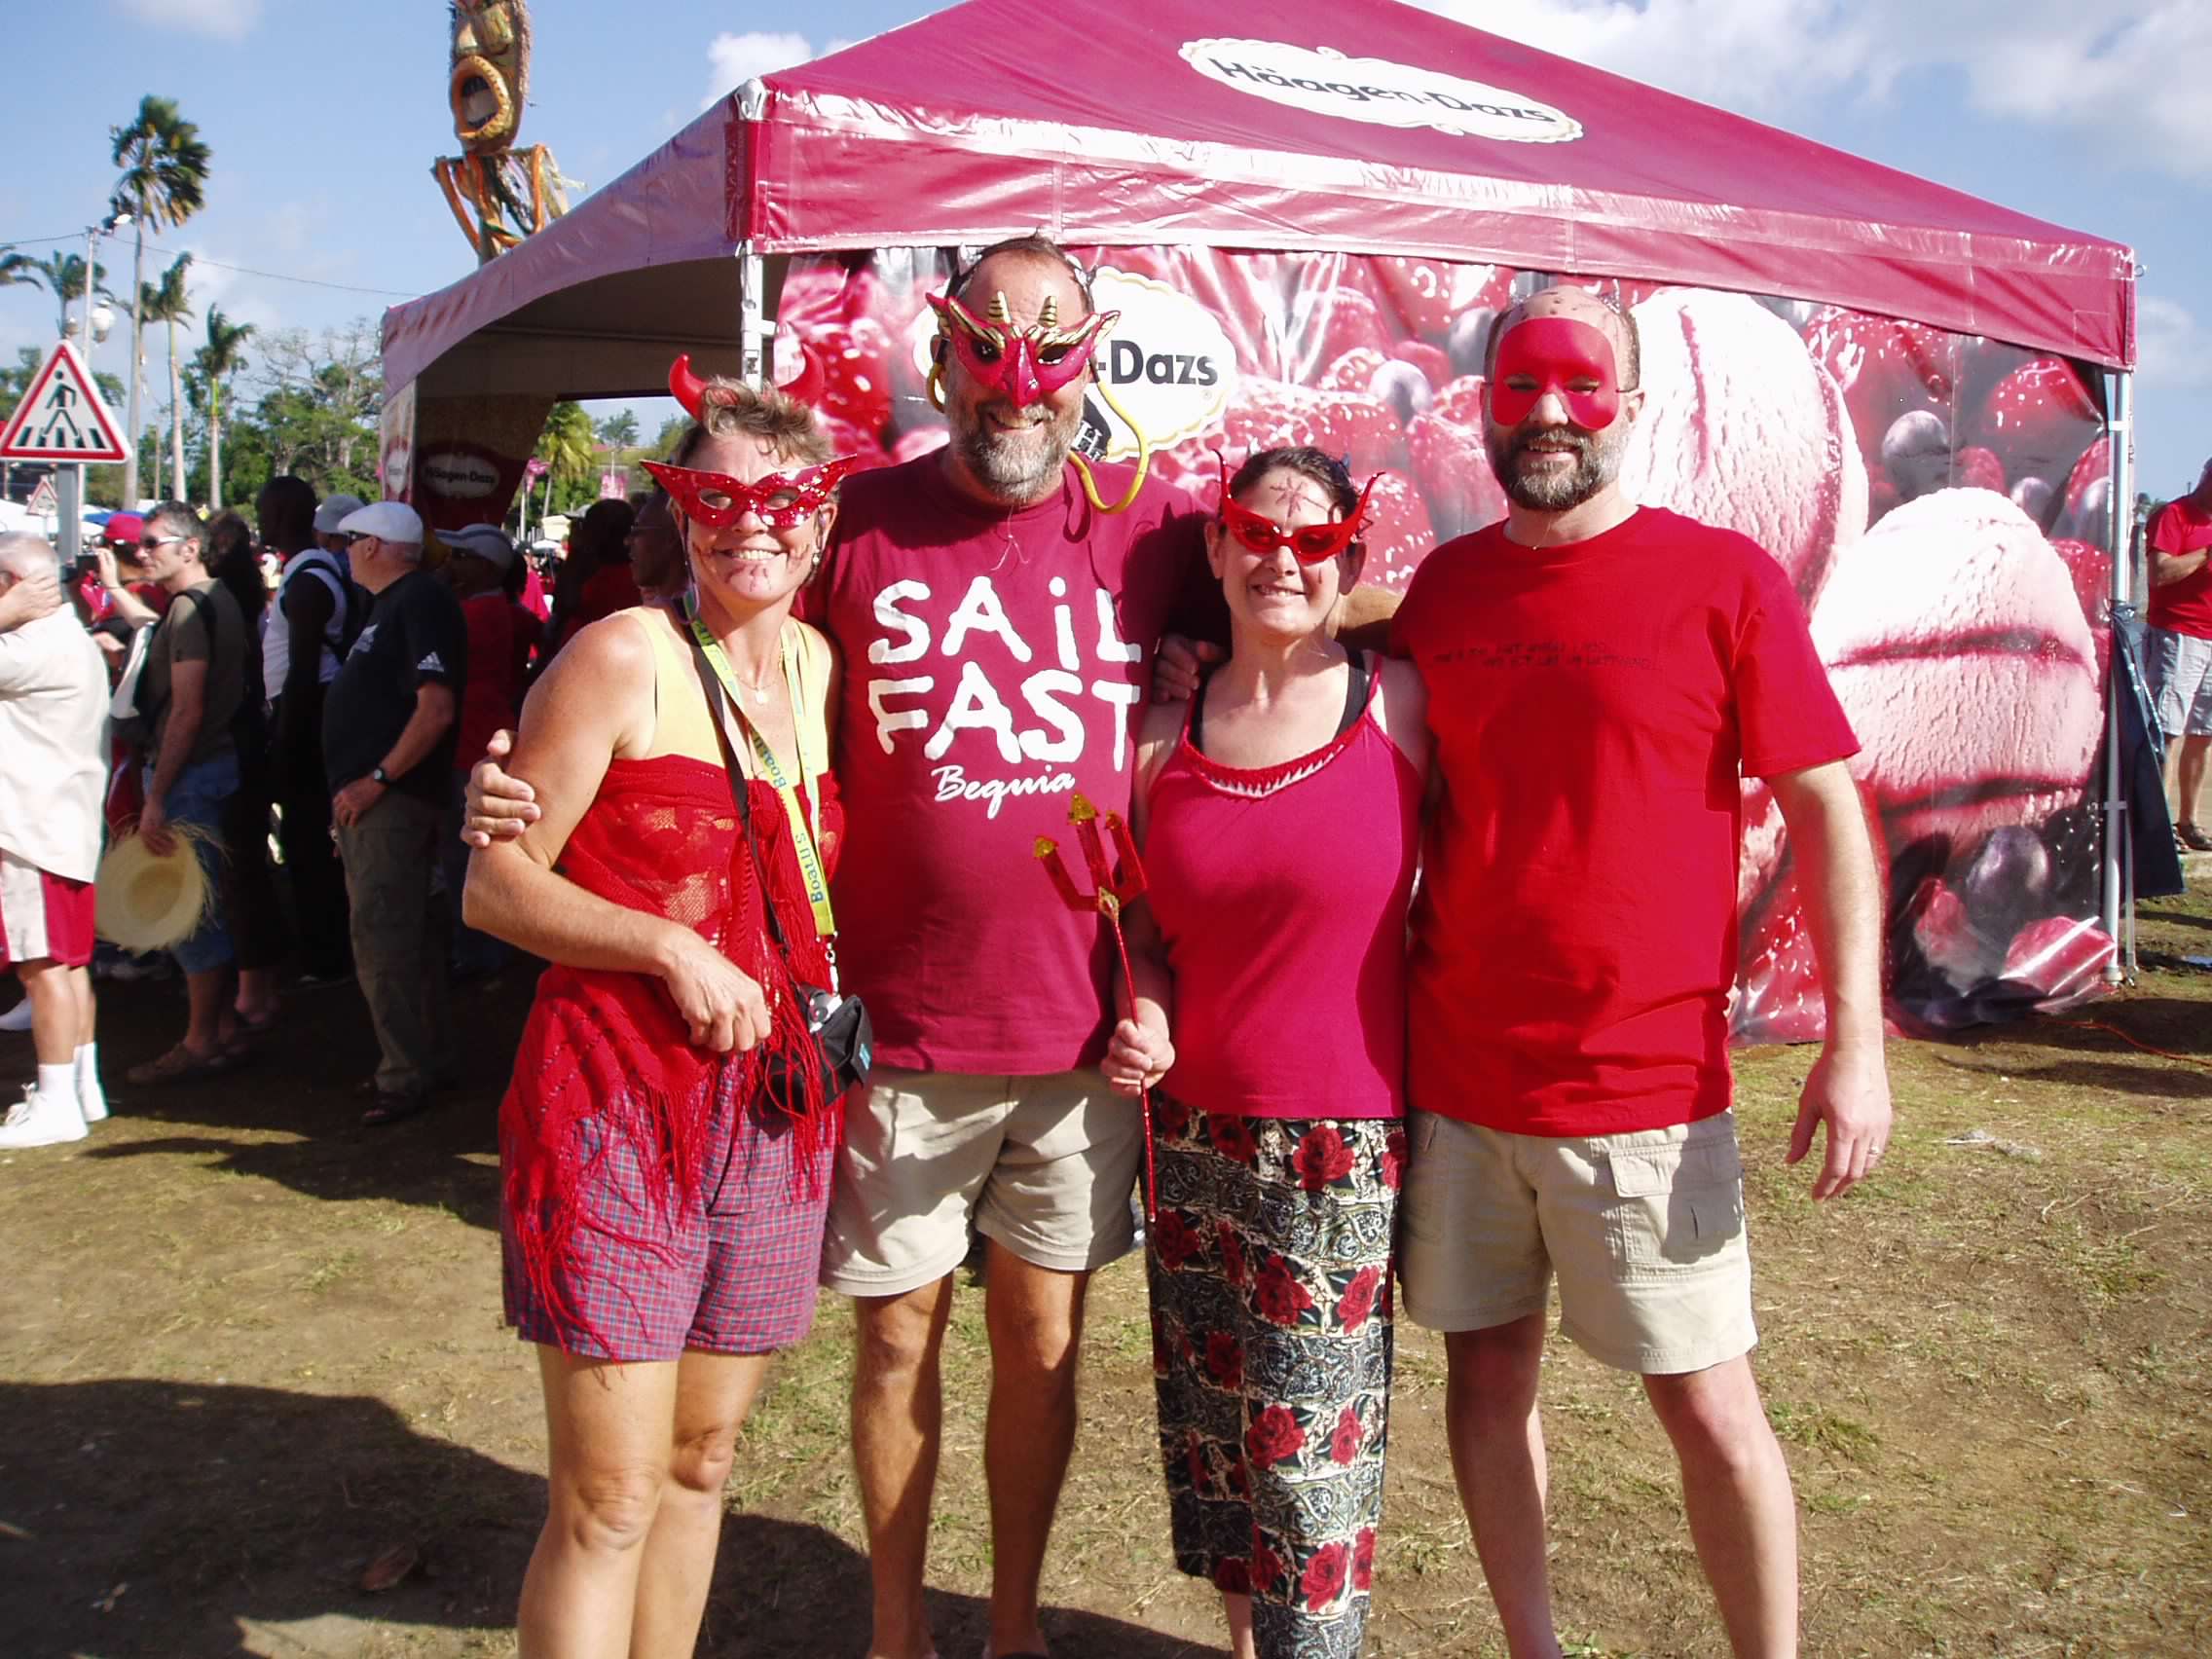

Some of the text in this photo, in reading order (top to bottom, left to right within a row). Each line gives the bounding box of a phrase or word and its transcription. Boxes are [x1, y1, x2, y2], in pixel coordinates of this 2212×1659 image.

[1206, 56, 1558, 124] Häagen-Dazs
[867, 661, 1141, 772] FAST
[930, 763, 1076, 820] Bequia
